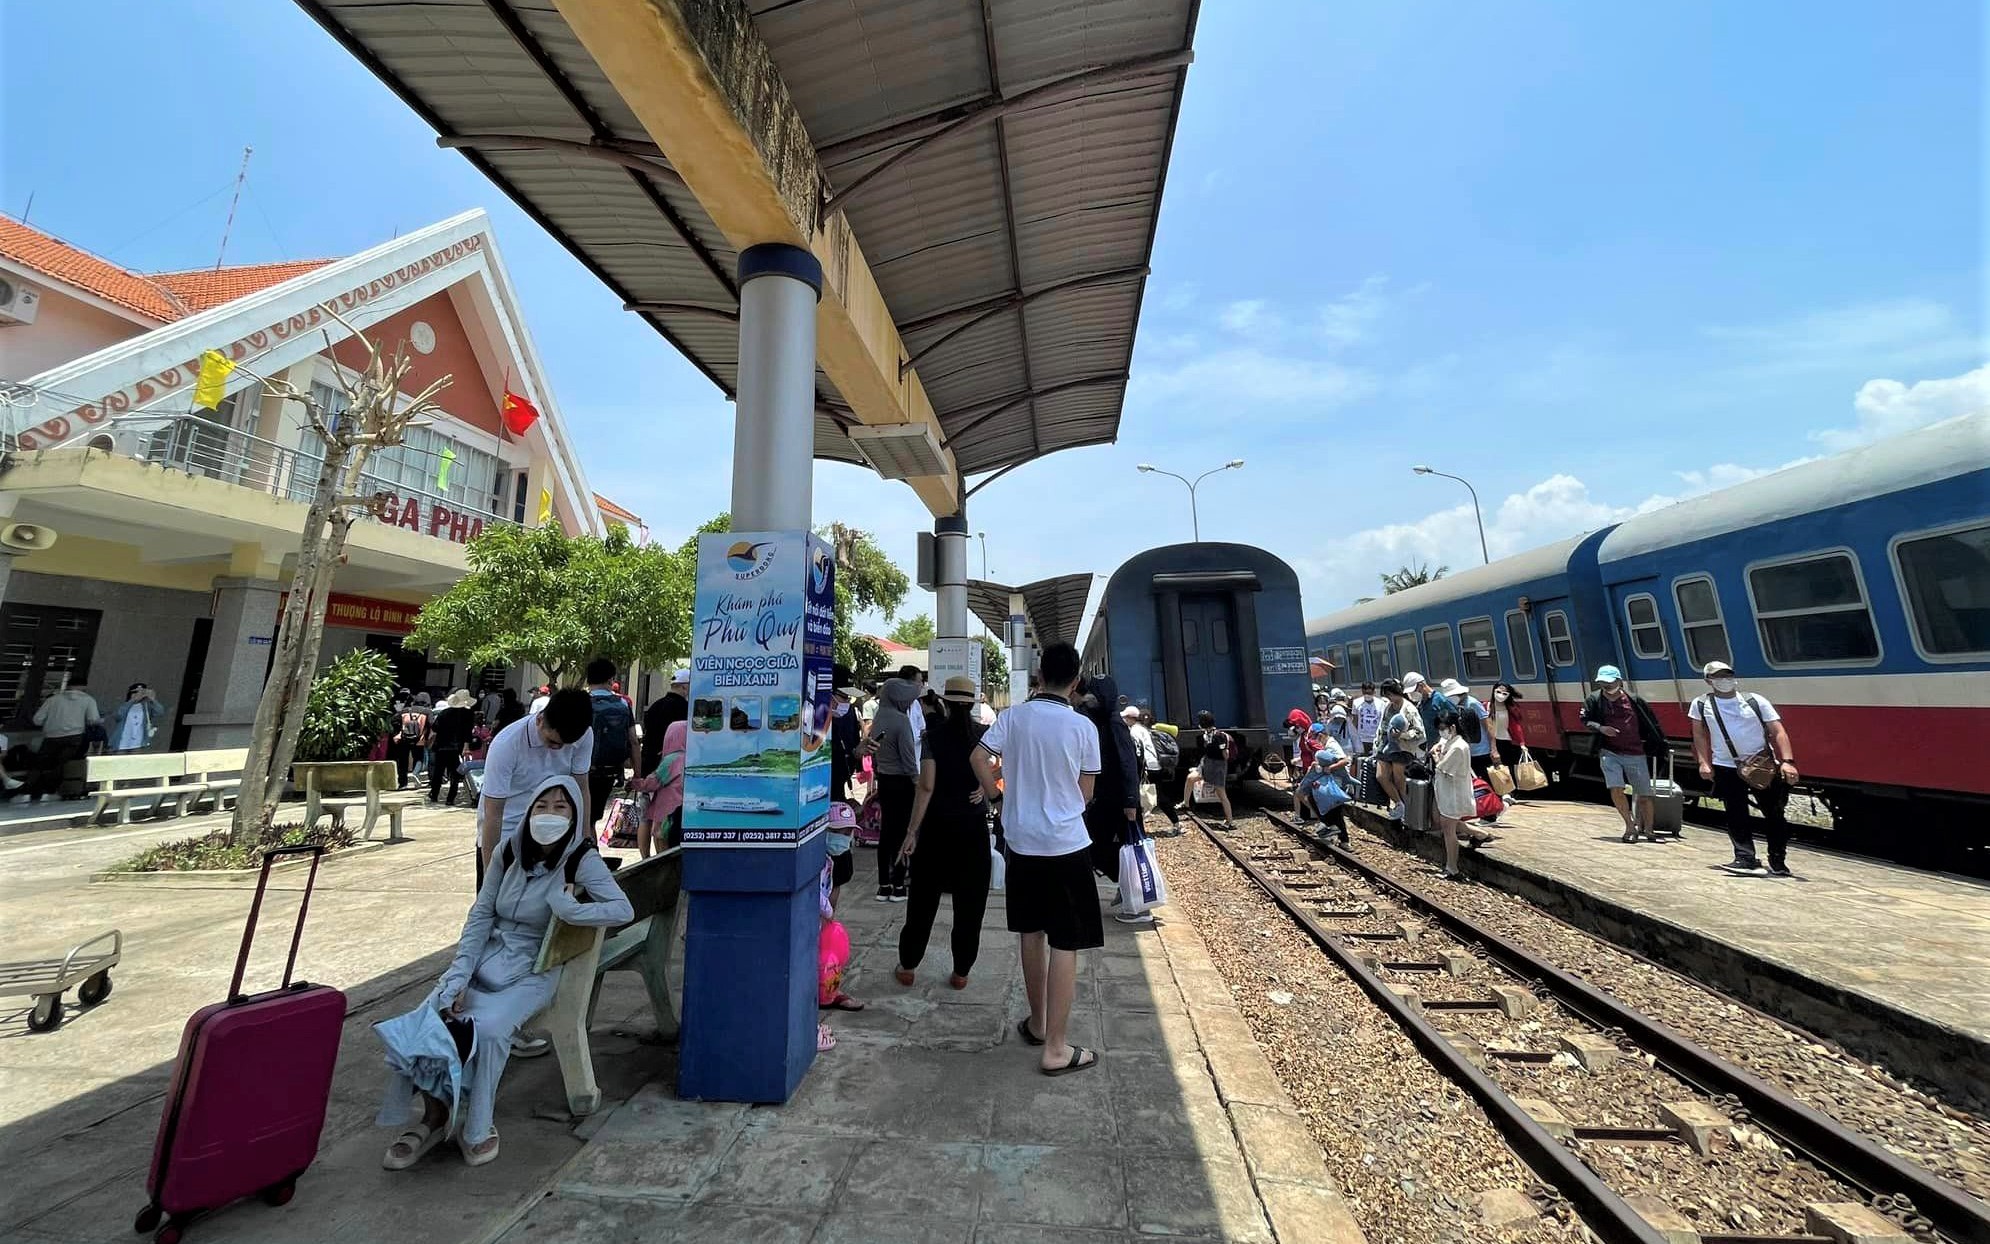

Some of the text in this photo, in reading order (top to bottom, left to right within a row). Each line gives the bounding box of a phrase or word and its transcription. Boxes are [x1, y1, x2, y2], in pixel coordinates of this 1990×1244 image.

[377, 491, 420, 533] GA
[735, 551, 774, 579] SUPERDONG
[715, 590, 783, 616] Khám phá
[701, 610, 802, 651] Phú Quý
[696, 653, 799, 674] VIÊN NGỌC GIỮA
[713, 671, 779, 687] BIỂN XANH
[765, 832, 780, 840] 3817
